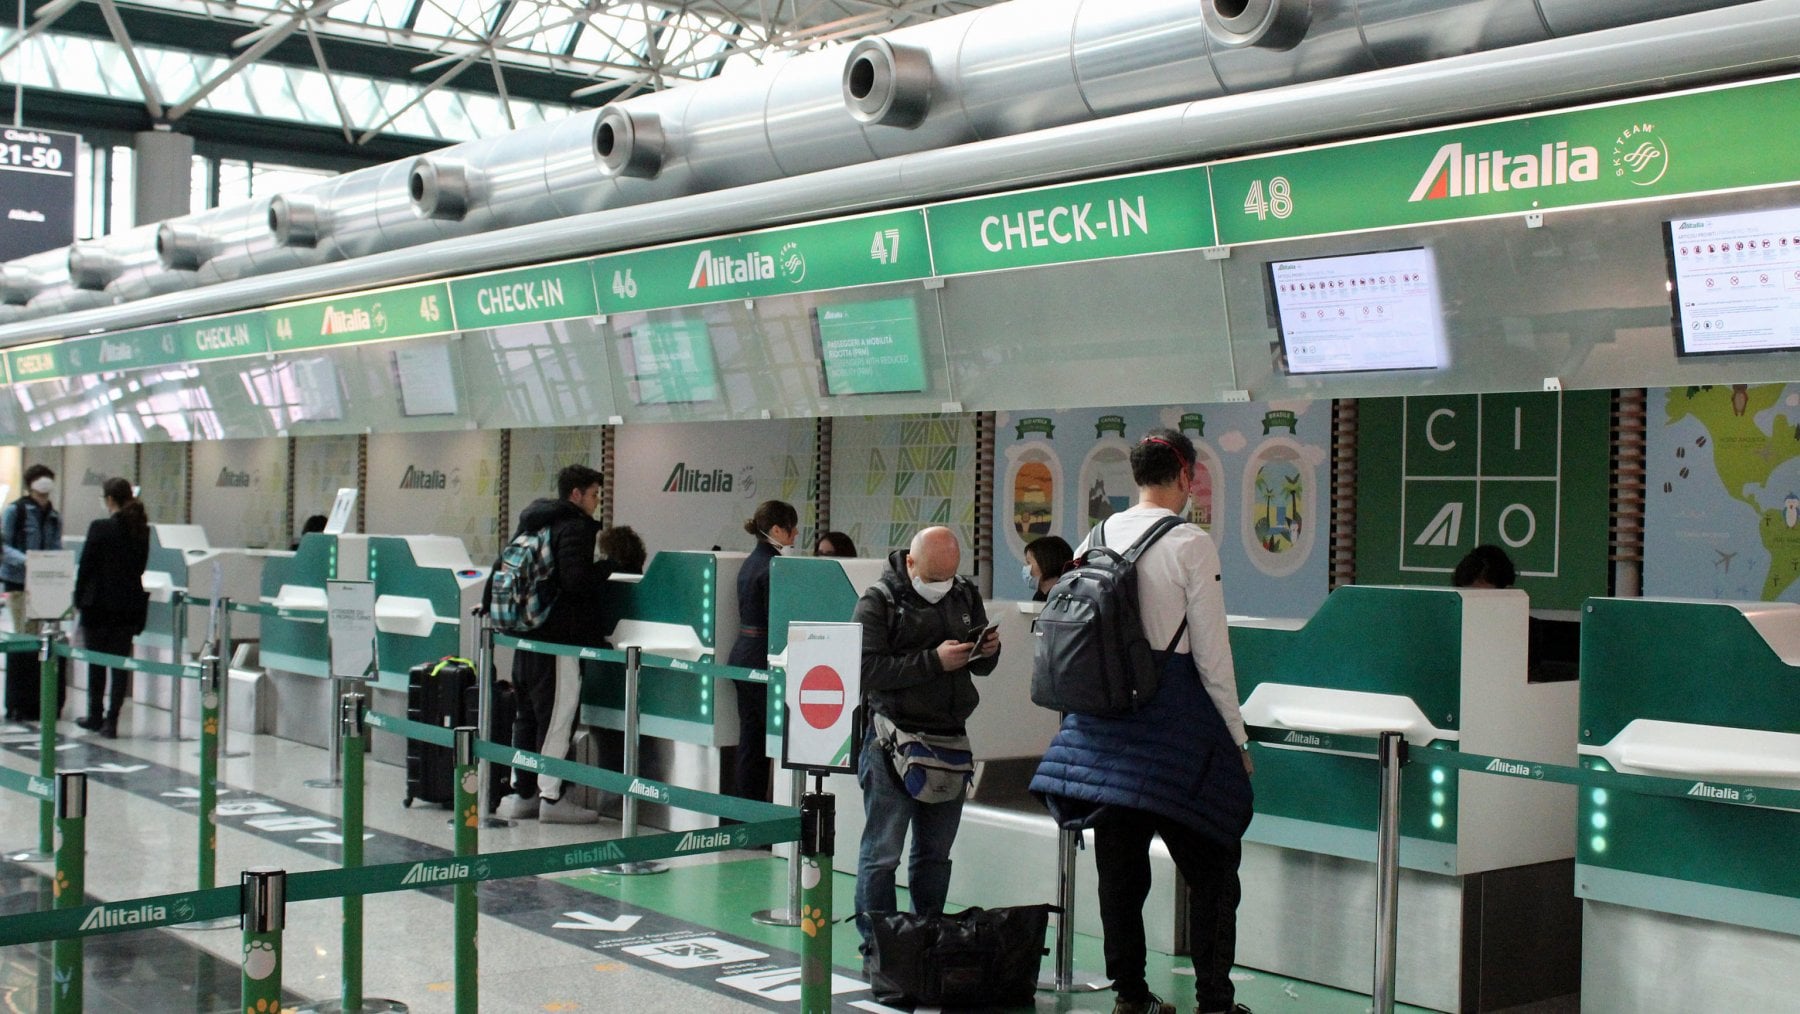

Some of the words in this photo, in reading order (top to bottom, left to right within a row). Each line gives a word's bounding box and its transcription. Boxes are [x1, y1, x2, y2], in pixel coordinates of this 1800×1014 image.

[1613, 122, 1654, 178] SKYTEAM
[1408, 141, 1598, 202] Alitalia
[1244, 176, 1293, 221] 48
[980, 195, 1148, 252] CHECK-IN
[870, 228, 900, 265] 47
[611, 268, 637, 299] 46
[688, 249, 775, 290] Alitalia
[419, 295, 440, 322] 45
[477, 278, 565, 316] CHECK-IN
[276, 317, 293, 341] 44
[321, 305, 371, 336] Alitalia
[195, 324, 250, 351] CHECK-IN
[1426, 408, 1456, 452] C
[400, 464, 446, 490] Alitalia
[662, 462, 733, 493] Alitalia
[1498, 503, 1536, 547] O
[1284, 731, 1320, 745] Alitalia
[512, 750, 538, 769] Alitalia
[1485, 758, 1530, 776] Alitalia
[628, 778, 659, 799] Alitalia
[1687, 782, 1739, 800] Alitalia
[675, 831, 731, 852] Alitalia
[400, 862, 469, 885] Alitalia
[79, 904, 166, 932] Alitalia
